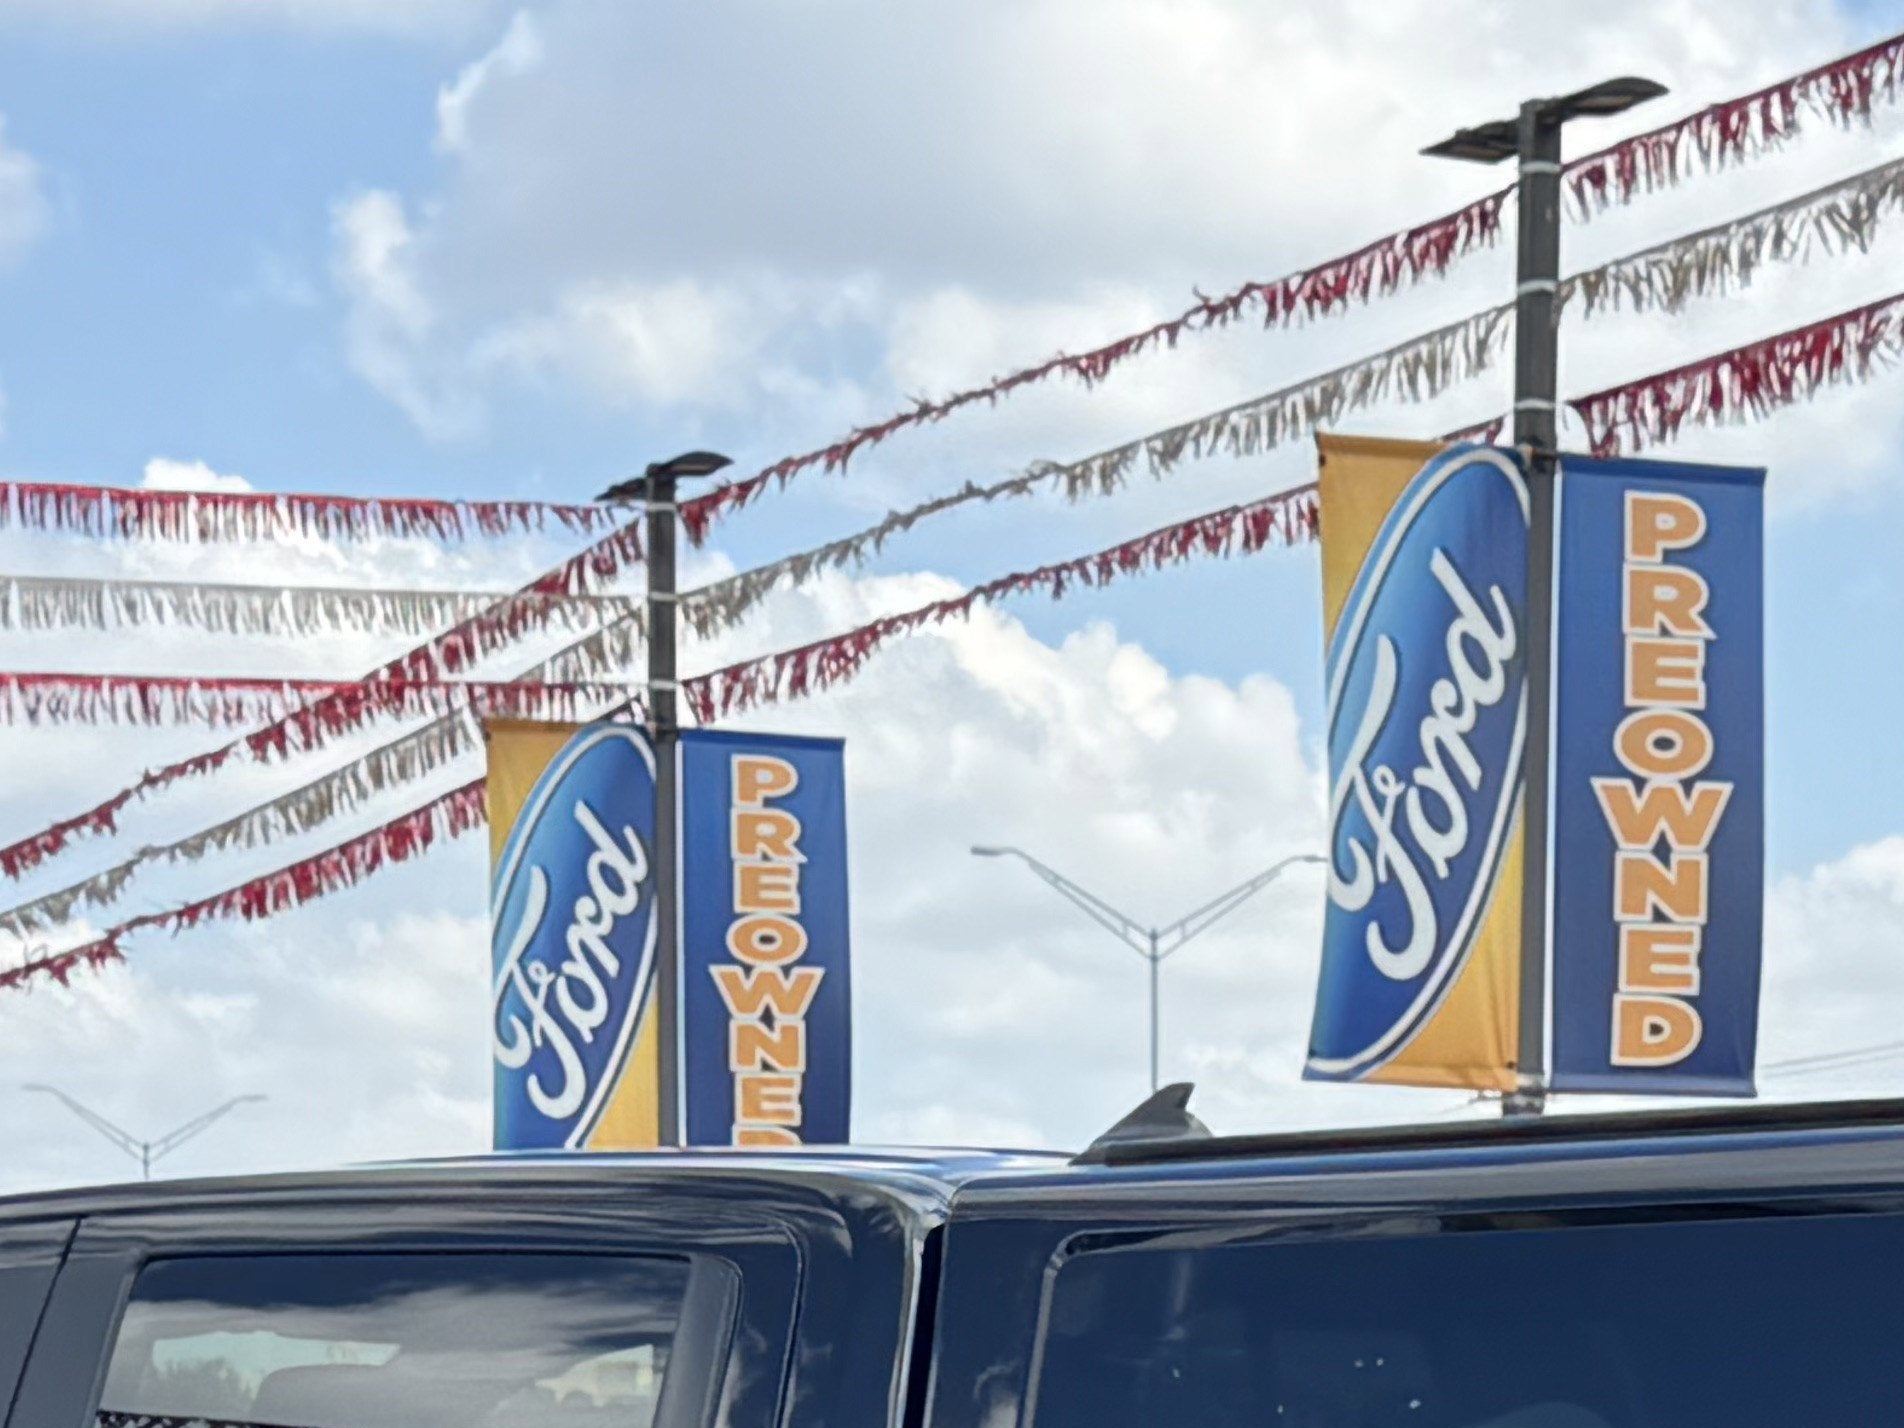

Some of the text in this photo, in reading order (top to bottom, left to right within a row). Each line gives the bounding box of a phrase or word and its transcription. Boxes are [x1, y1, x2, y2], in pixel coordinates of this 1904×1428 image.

[494, 800, 649, 1120] Ford
[1328, 546, 1517, 980] Ford
[1590, 488, 1735, 1067] PREOWNED
